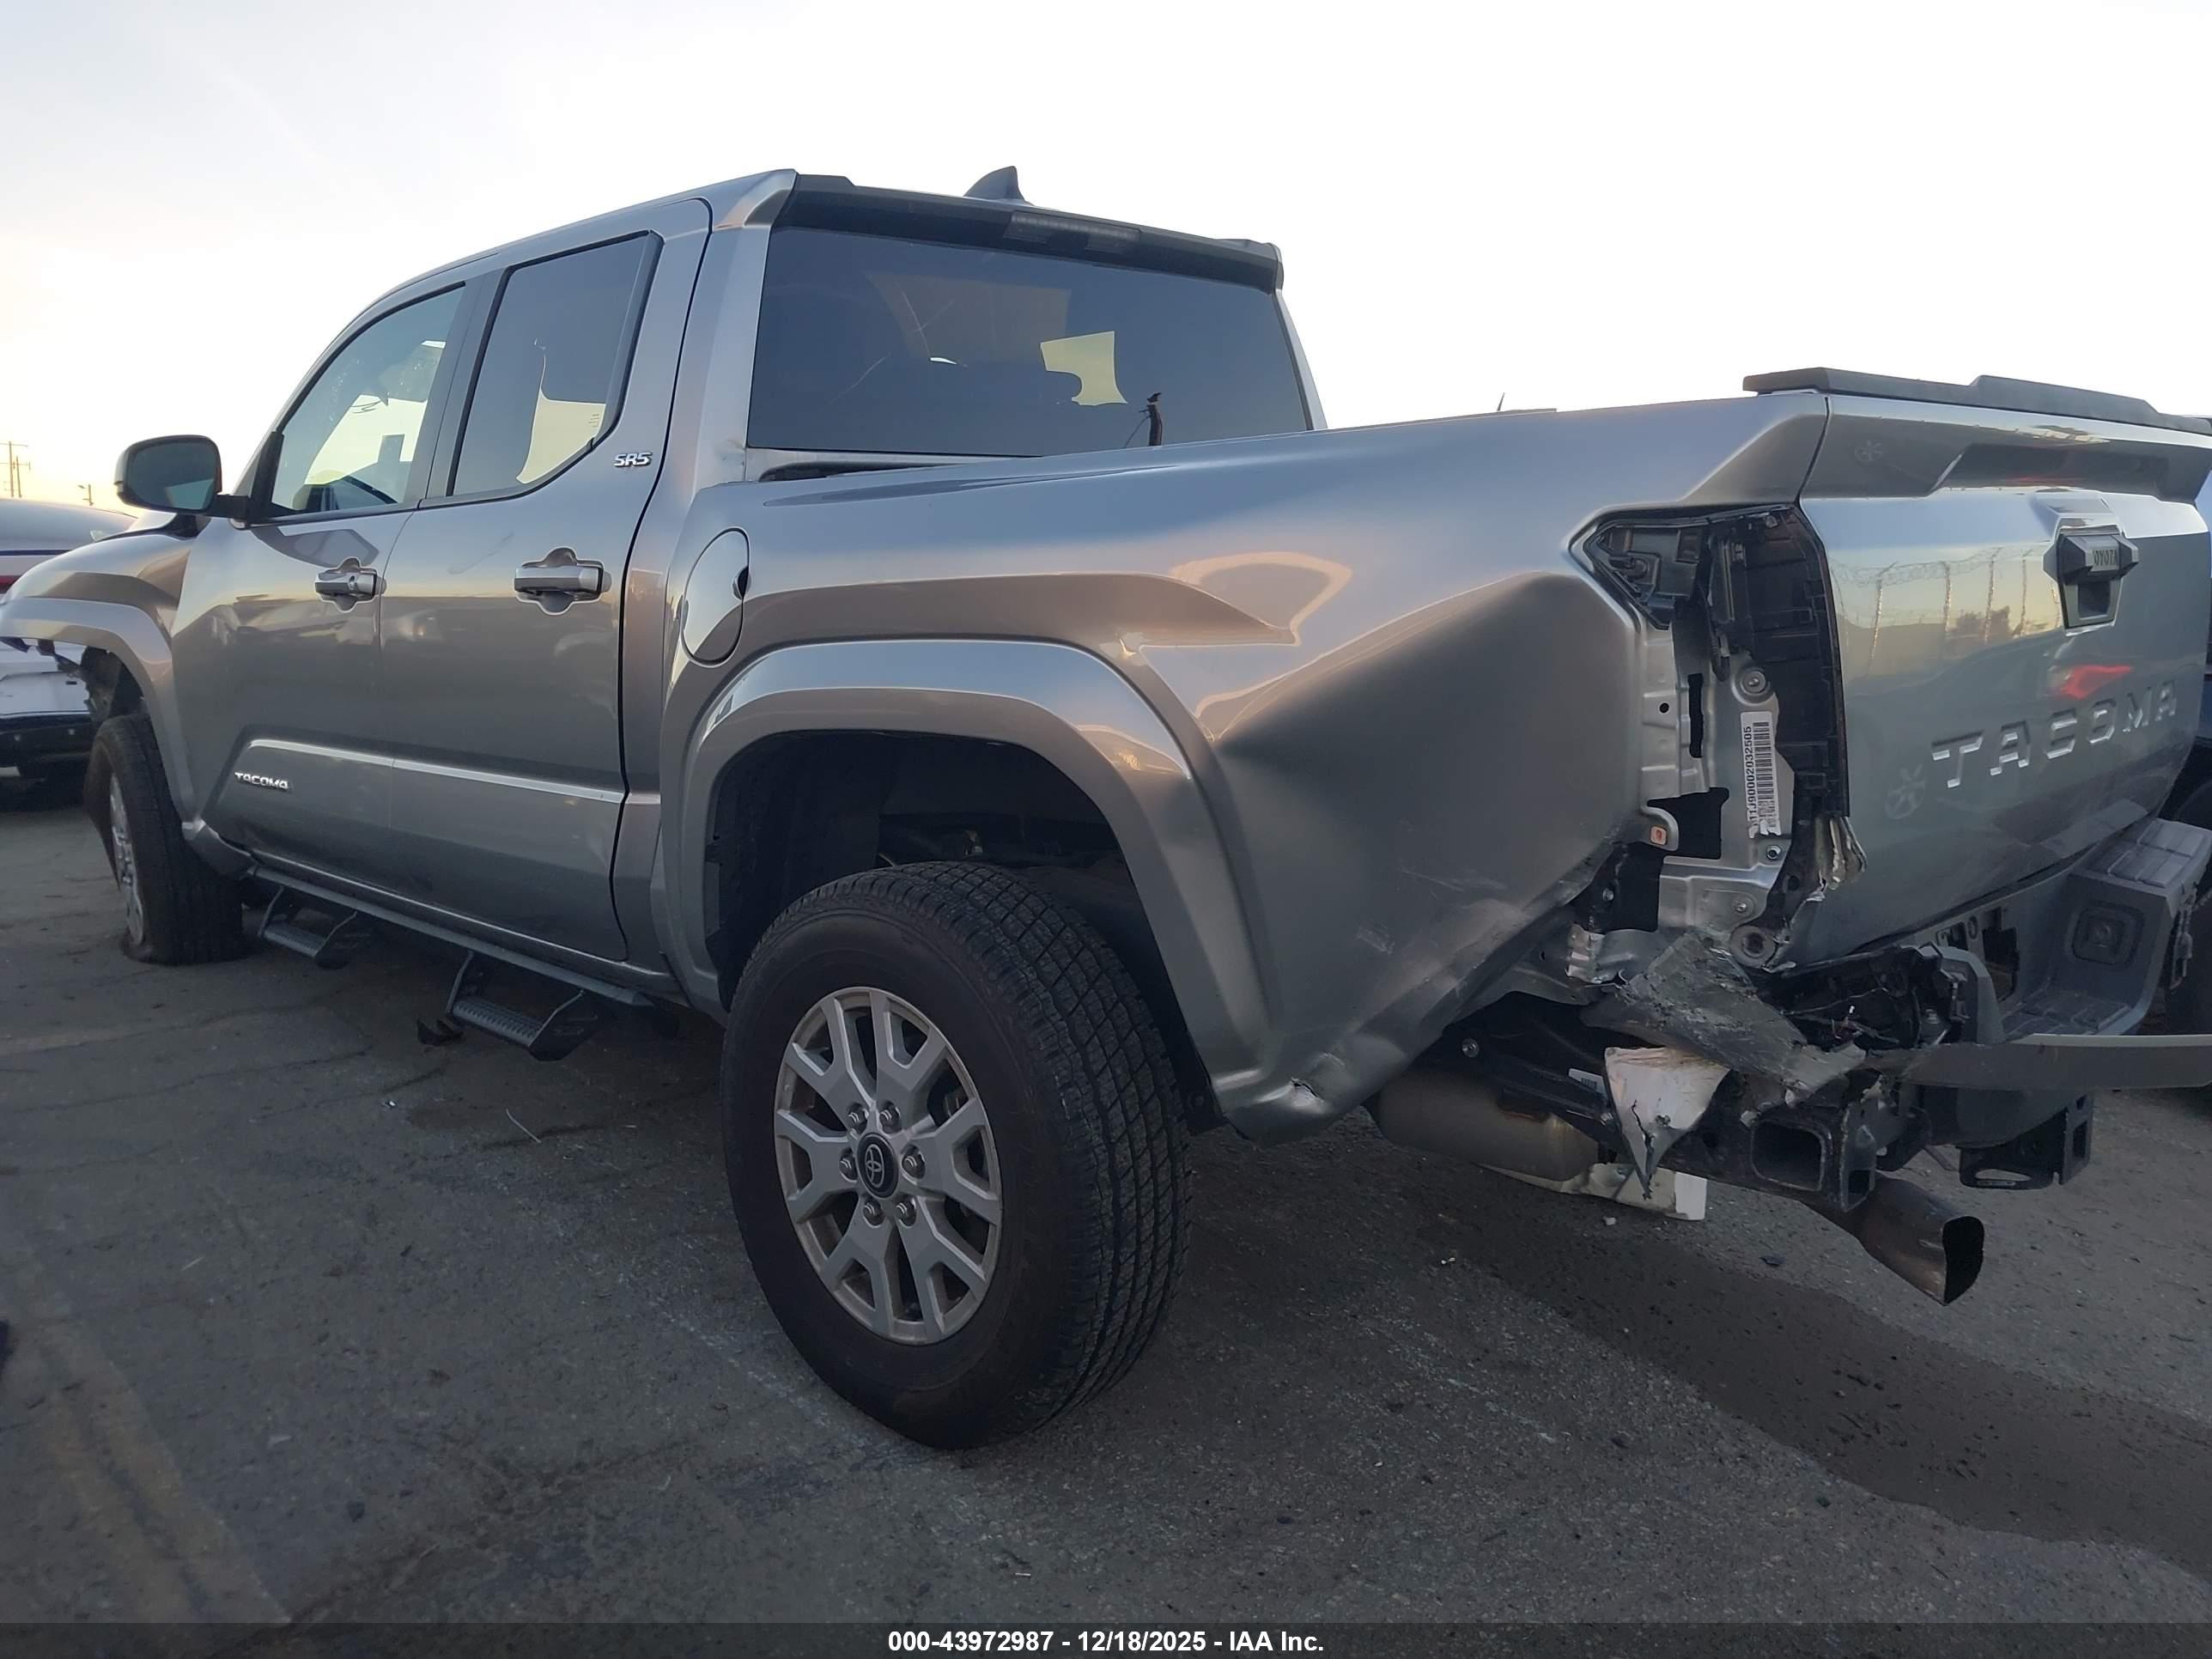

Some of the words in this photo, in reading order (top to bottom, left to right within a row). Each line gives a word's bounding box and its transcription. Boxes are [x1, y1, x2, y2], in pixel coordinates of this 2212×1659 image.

[613, 451, 653, 468] SR5
[1929, 679, 2177, 789] TACOMA
[234, 772, 289, 790] TACOMA
